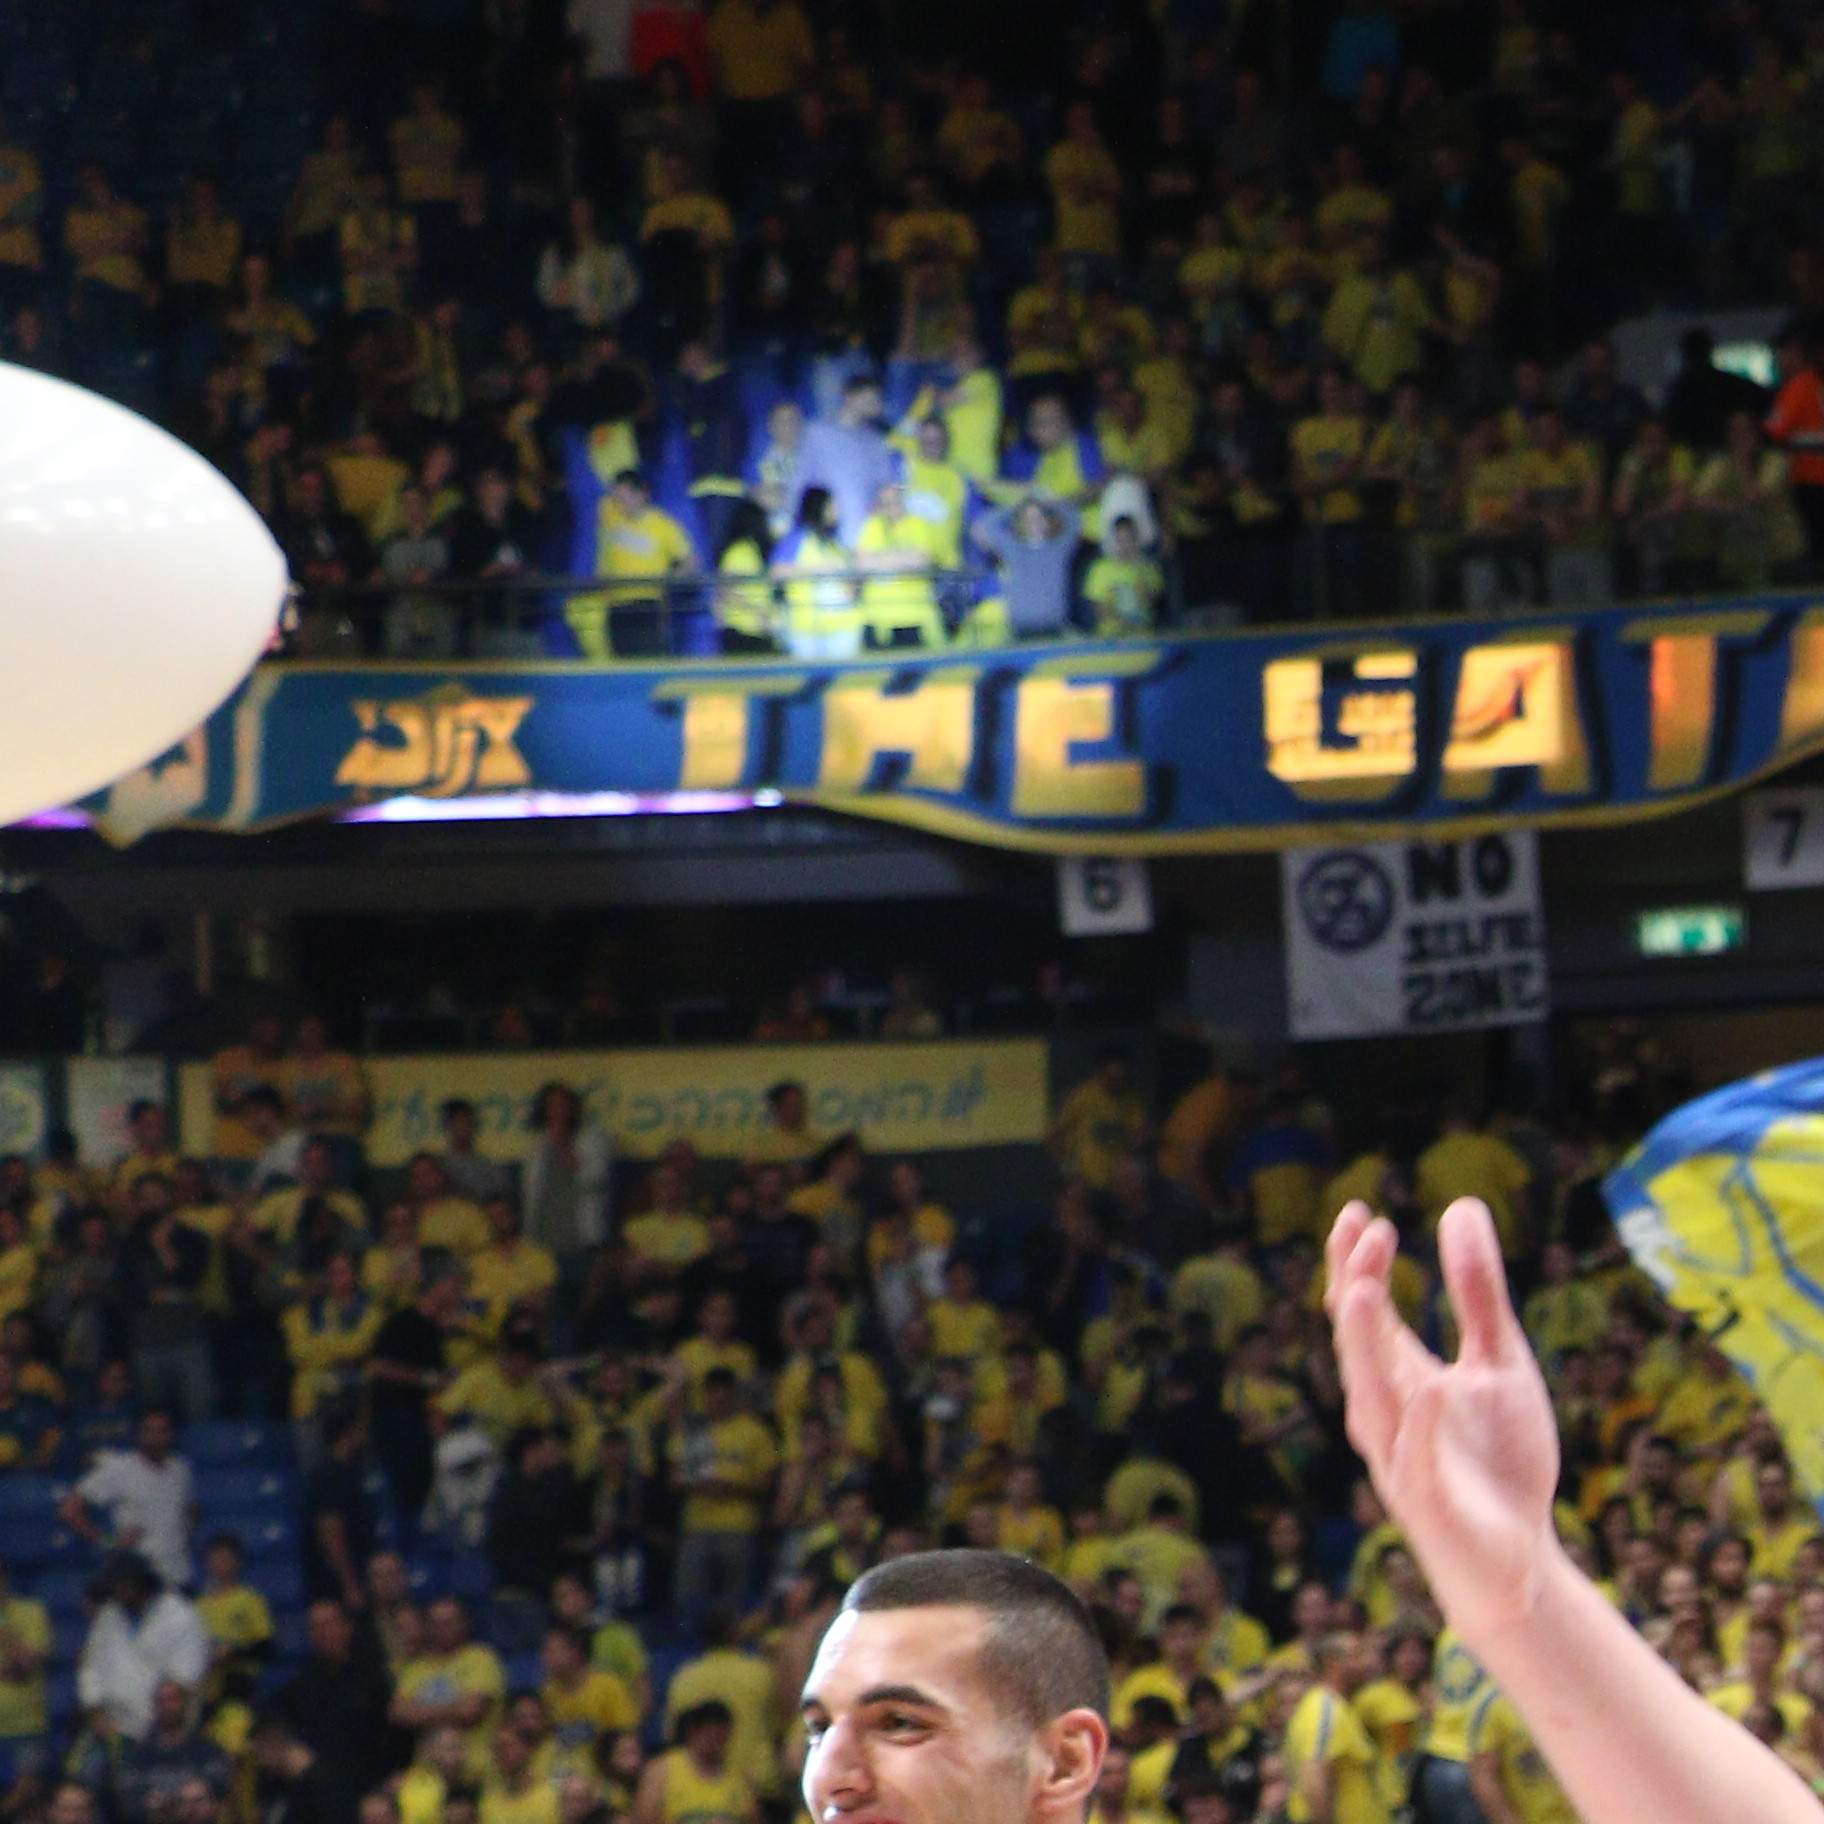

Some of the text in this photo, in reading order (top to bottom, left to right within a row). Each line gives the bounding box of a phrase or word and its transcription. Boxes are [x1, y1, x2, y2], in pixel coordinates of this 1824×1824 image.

[652, 650, 1168, 818] THE
[1405, 836, 1514, 904] NO
[1768, 805, 1807, 869] 7
[1082, 864, 1124, 914] 6
